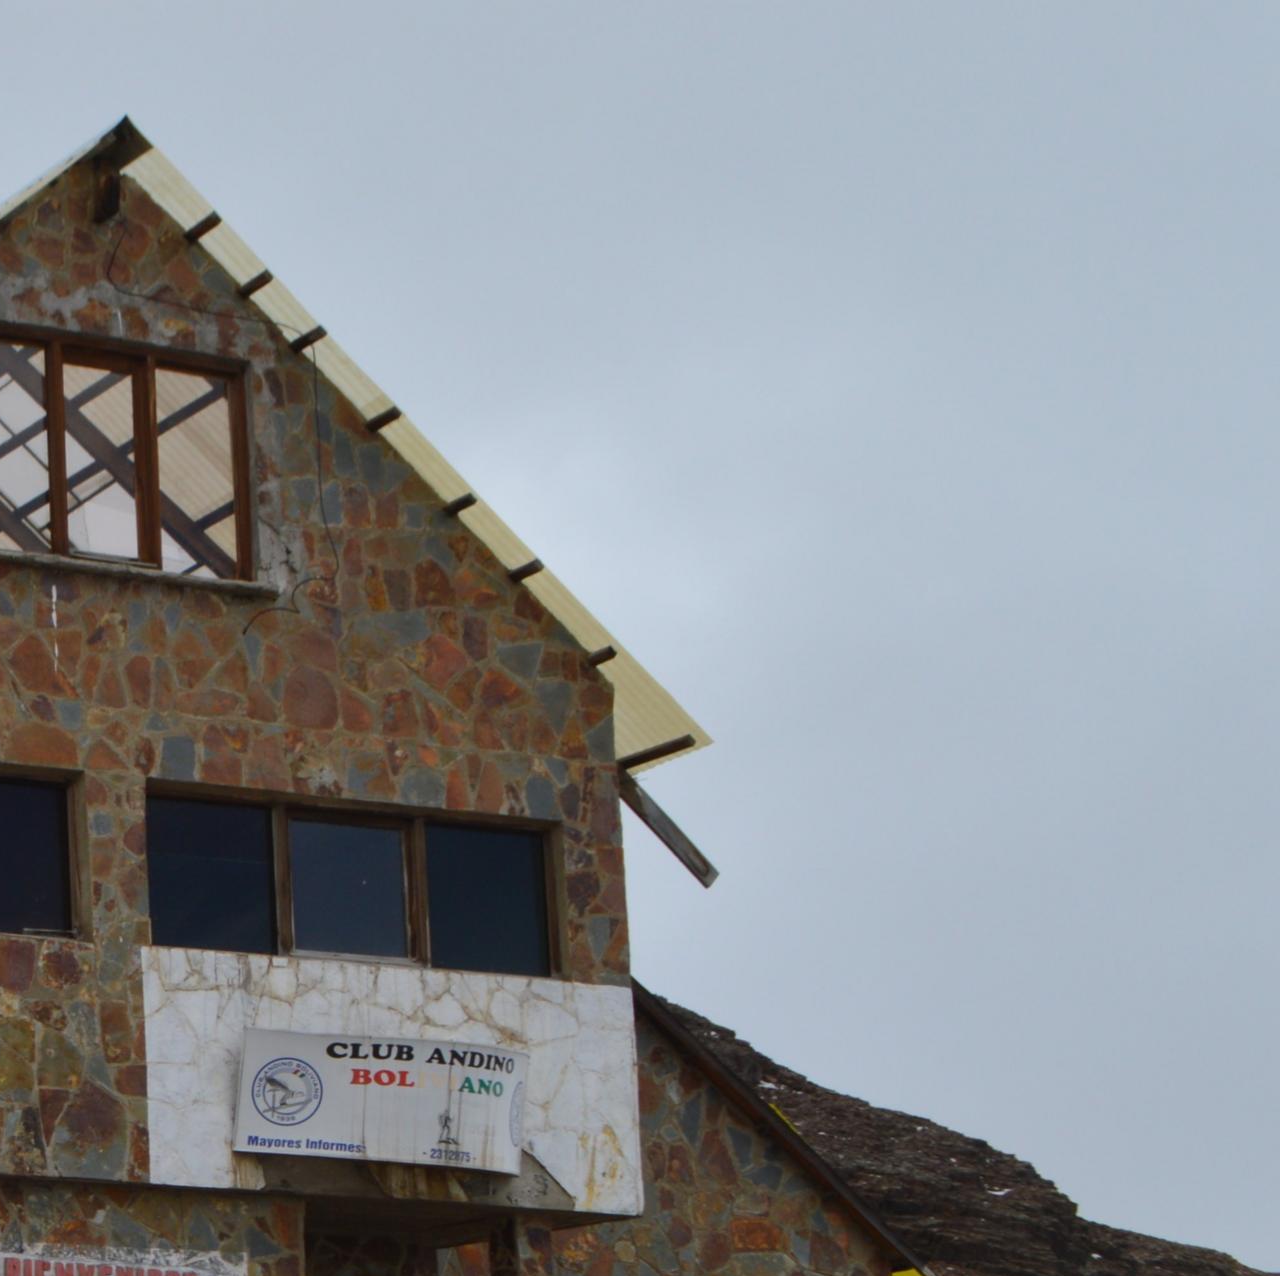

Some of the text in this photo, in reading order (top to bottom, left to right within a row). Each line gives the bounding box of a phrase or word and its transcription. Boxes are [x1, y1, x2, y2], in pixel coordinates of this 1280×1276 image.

[326, 1042, 514, 1073] CLUB ANDINO
[247, 1135, 302, 1150] Mayores
